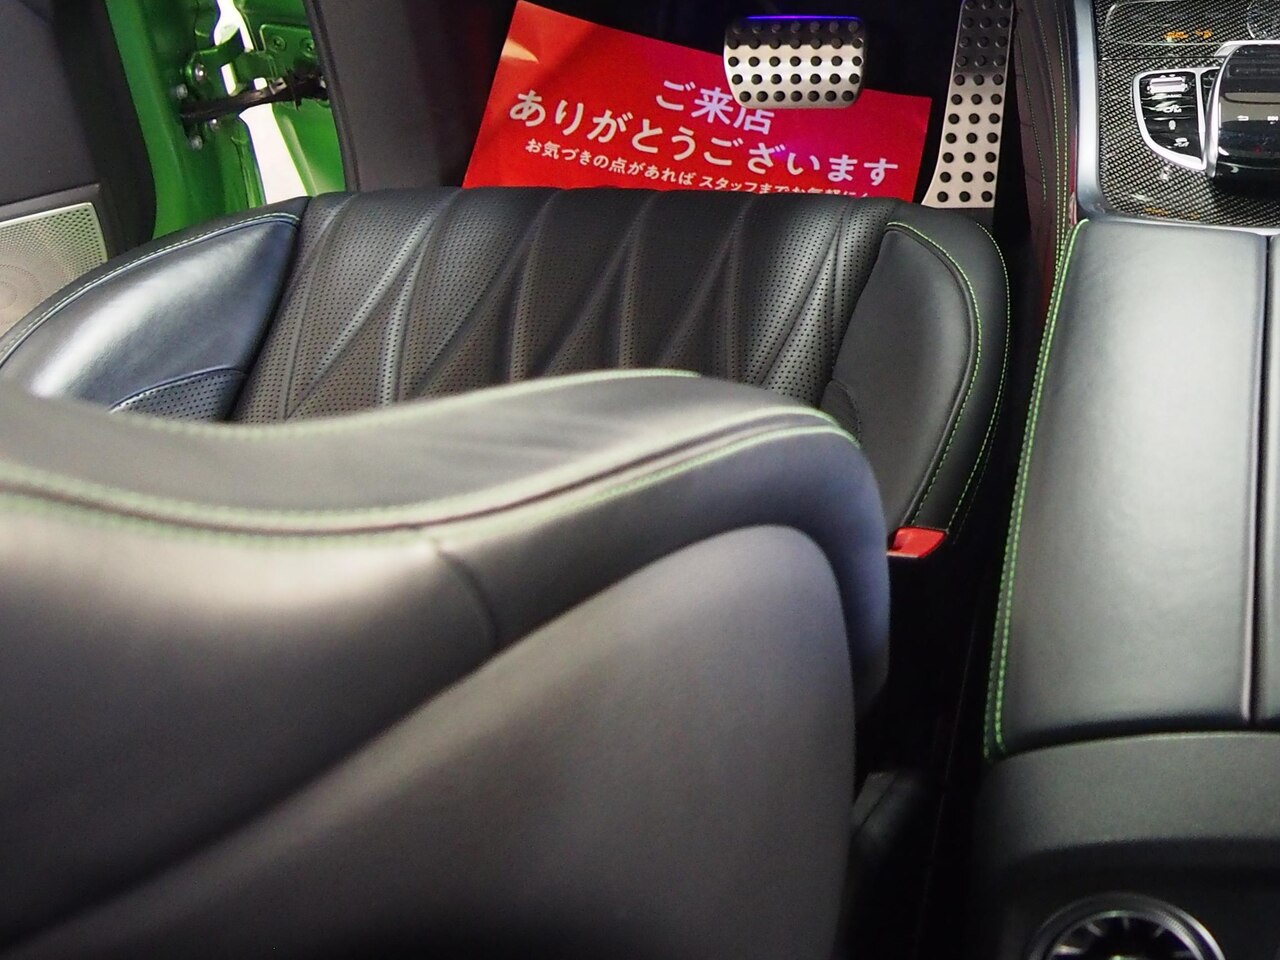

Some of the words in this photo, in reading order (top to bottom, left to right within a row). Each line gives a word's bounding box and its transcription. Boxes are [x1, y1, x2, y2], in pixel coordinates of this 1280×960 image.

[655, 79, 775, 135] ご来店
[509, 89, 899, 186] ありがとうございます
[525, 138, 696, 186] お気づきの点があれば
